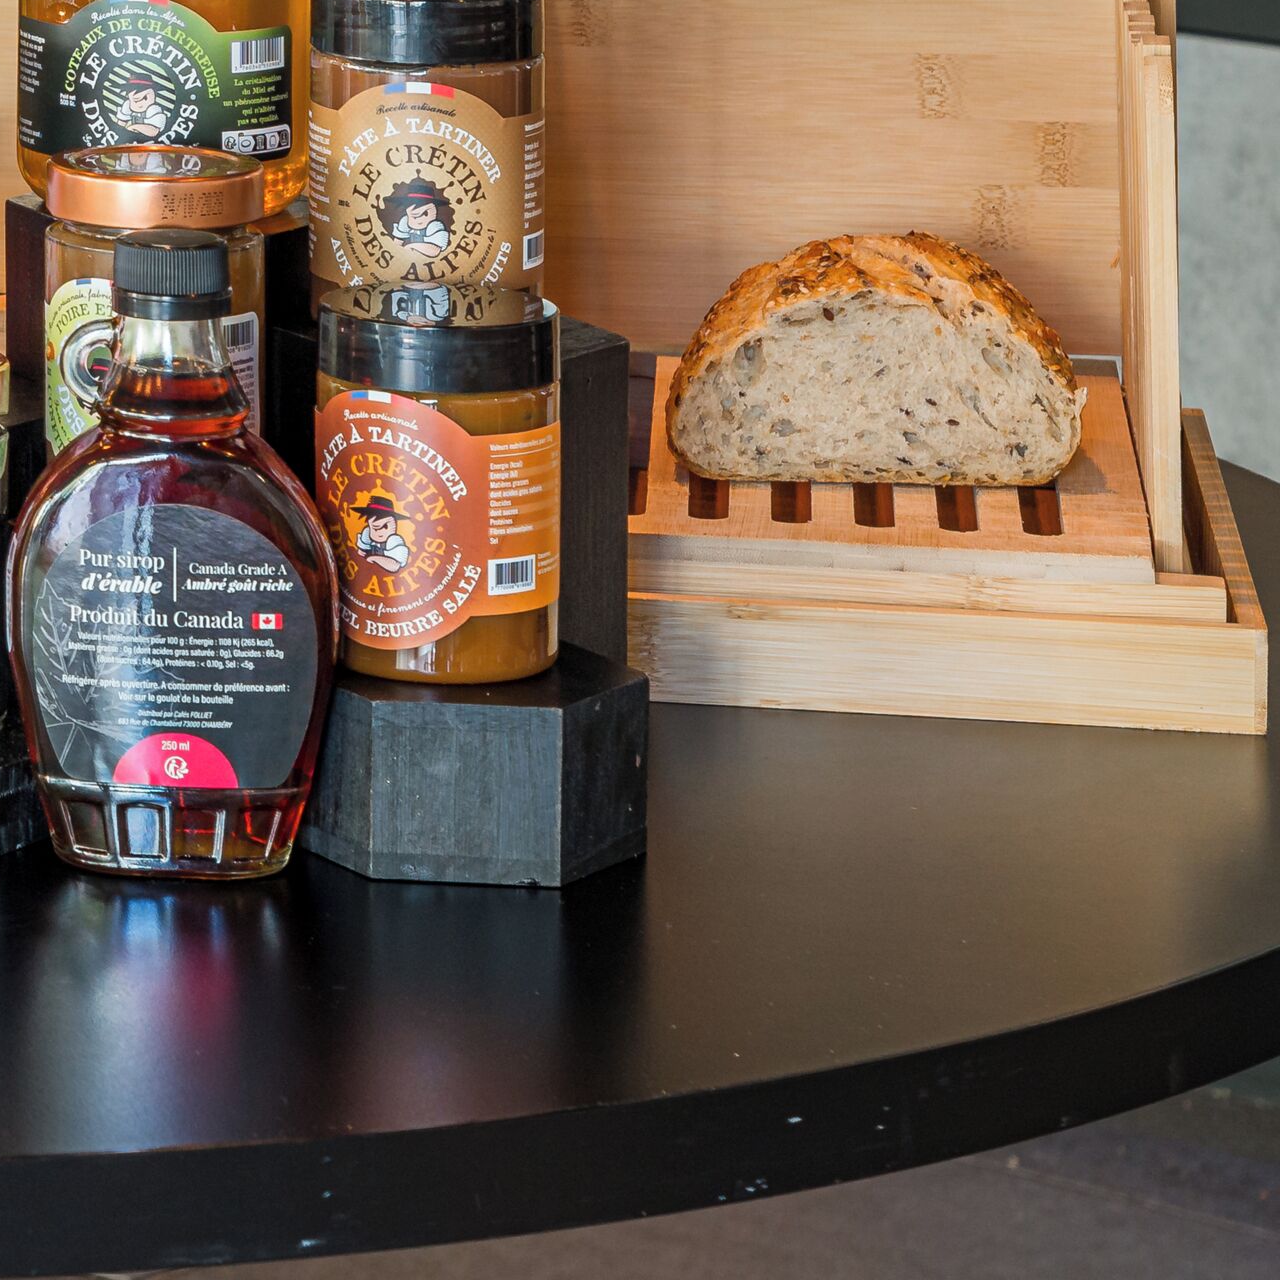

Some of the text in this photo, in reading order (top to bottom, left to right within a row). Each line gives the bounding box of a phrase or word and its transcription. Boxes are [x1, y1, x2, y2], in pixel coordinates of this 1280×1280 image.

[122, 5, 186, 27] dans Alpes
[64, 25, 106, 92] COTEAUX
[107, 18, 133, 33] DE
[137, 18, 221, 99] CHARTREUSE
[80, 52, 107, 89] LE
[108, 34, 202, 90] CRÉTIN
[242, 86, 266, 96] du Miel
[242, 108, 253, 117] qui
[376, 102, 456, 117] Recette artisanale
[82, 98, 119, 147] DES
[237, 118, 249, 127] pas
[338, 126, 379, 177] PÂTE
[383, 116, 400, 137] À
[406, 117, 502, 184] TARTINER
[352, 162, 382, 202] LE
[385, 143, 487, 204] CRÉTIN
[330, 237, 353, 276] AUX
[343, 223, 368, 269] Tellement
[354, 214, 484, 282] DES ALPES
[55, 303, 90, 335] POIRE
[343, 409, 419, 431] Recette artisanale
[321, 423, 468, 502] PÂTE À TARTINER
[328, 452, 451, 520] LE CRÉTIN
[80, 549, 165, 573] Pur sirop
[189, 562, 287, 576] Canada Grade A
[363, 537, 447, 598] ALPES
[81, 572, 163, 595] d'érable
[181, 578, 294, 593] Ambré goût riche
[365, 610, 444, 637] BEURRE
[443, 564, 482, 614] SALÉ
[377, 598, 423, 617] finement
[70, 605, 244, 629] Produit du Canada
[68, 641, 96, 651] Matières
[152, 647, 174, 656] acides
[174, 649, 190, 657] gras
[190, 648, 215, 657] saturée
[233, 649, 261, 658] Glucides
[266, 649, 284, 659] 66.2g
[78, 631, 101, 641] Valeurs
[151, 637, 166, 645] pour
[167, 637, 178, 645] 100
[189, 636, 214, 647] Énergie
[219, 638, 232, 646] 1108
[241, 638, 256, 647] (265
[165, 659, 236, 668] Protéines Sel
[62, 674, 286, 693] Réfrigérer après ouverture. consommer de préférence avant
[118, 692, 234, 704] Voir sur le goulot de la bouteille
[190, 711, 213, 719] FOLLIET
[201, 720, 233, 729] CHAMBÉRY
[161, 740, 190, 751] 250 ml
